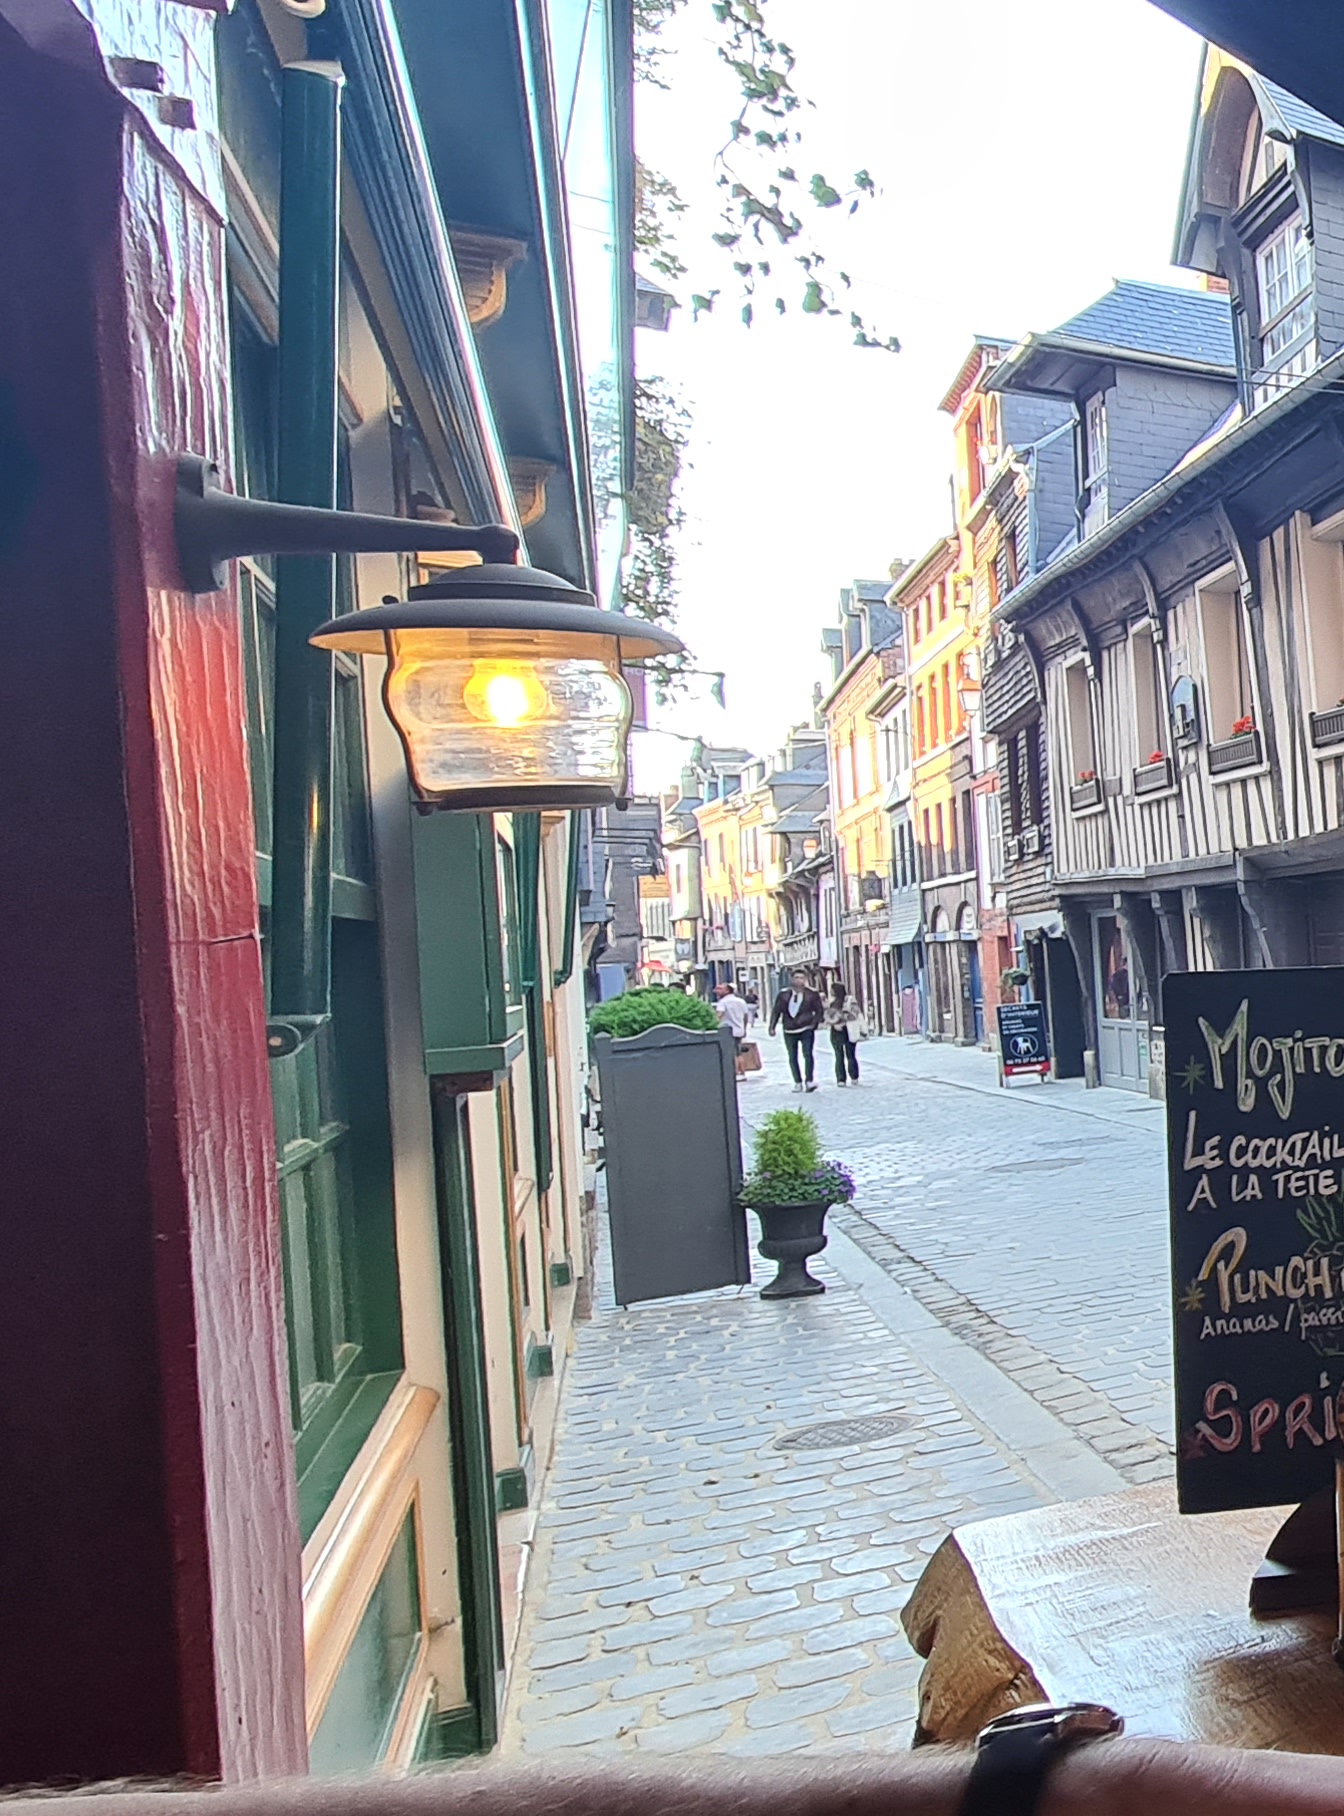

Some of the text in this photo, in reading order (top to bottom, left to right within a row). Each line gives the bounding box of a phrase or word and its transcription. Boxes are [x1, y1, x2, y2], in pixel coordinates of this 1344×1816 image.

[1186, 1174, 1217, 1213] A
[1230, 1172, 1263, 1202] LA
[1198, 1226, 1334, 1314] PUNCH
[1200, 1314, 1280, 1340] Ananas
